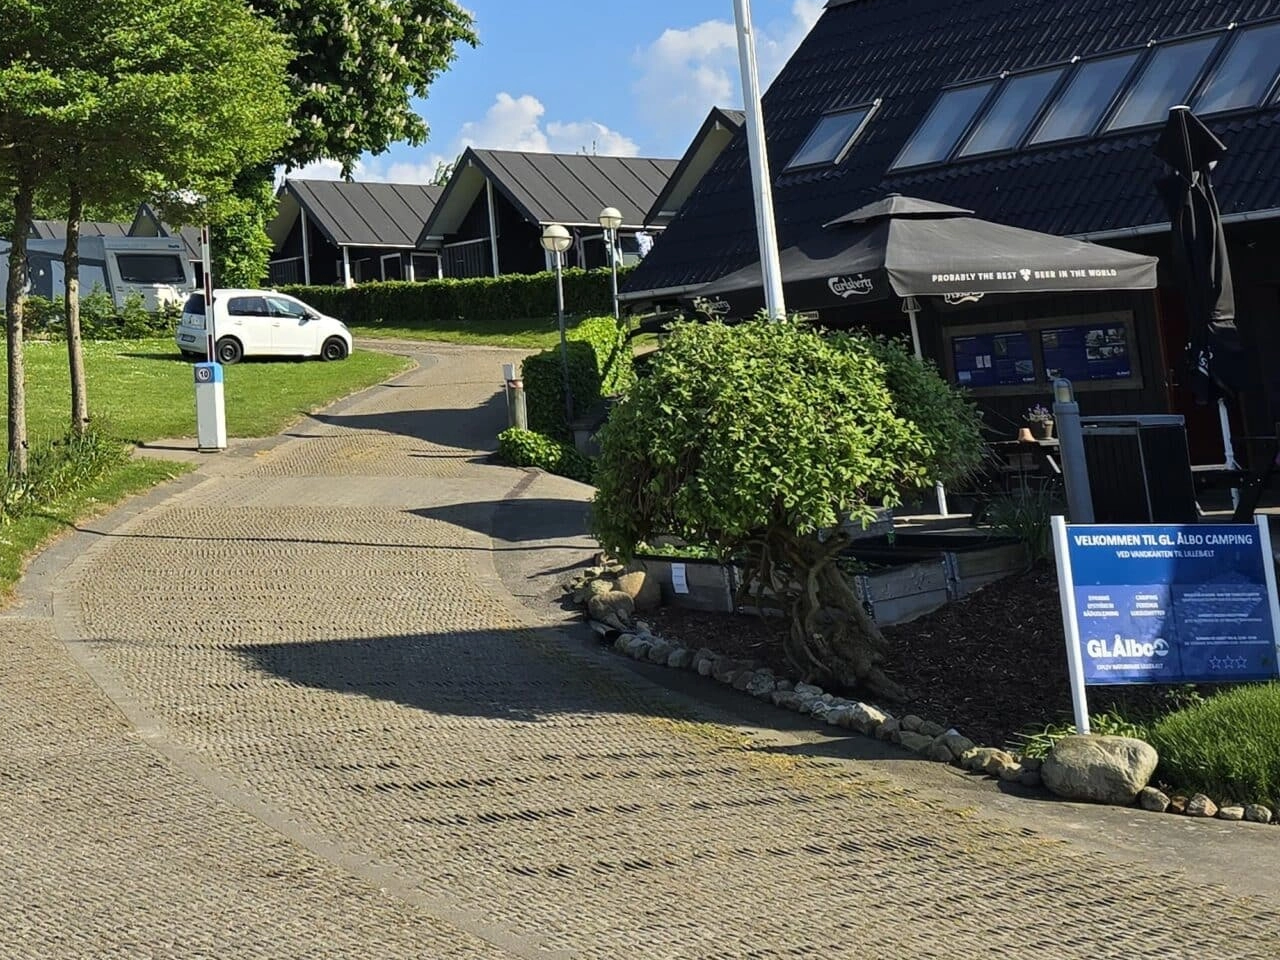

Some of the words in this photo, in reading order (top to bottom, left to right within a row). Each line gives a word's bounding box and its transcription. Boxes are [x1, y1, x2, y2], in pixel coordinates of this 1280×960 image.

[932, 273, 976, 283] PROBABLY
[978, 272, 994, 281] THE
[996, 271, 1017, 280] BEST
[1034, 270, 1056, 279] BEER
[1058, 270, 1068, 278] IN
[1070, 269, 1086, 278] THE
[1088, 268, 1117, 278] WORLD
[1074, 534, 1141, 546] VELKOMMEN
[1142, 534, 1158, 546] TIL
[1158, 534, 1175, 546] GL.
[1177, 531, 1203, 545] ÅLBO
[1205, 534, 1253, 545] CAMPING
